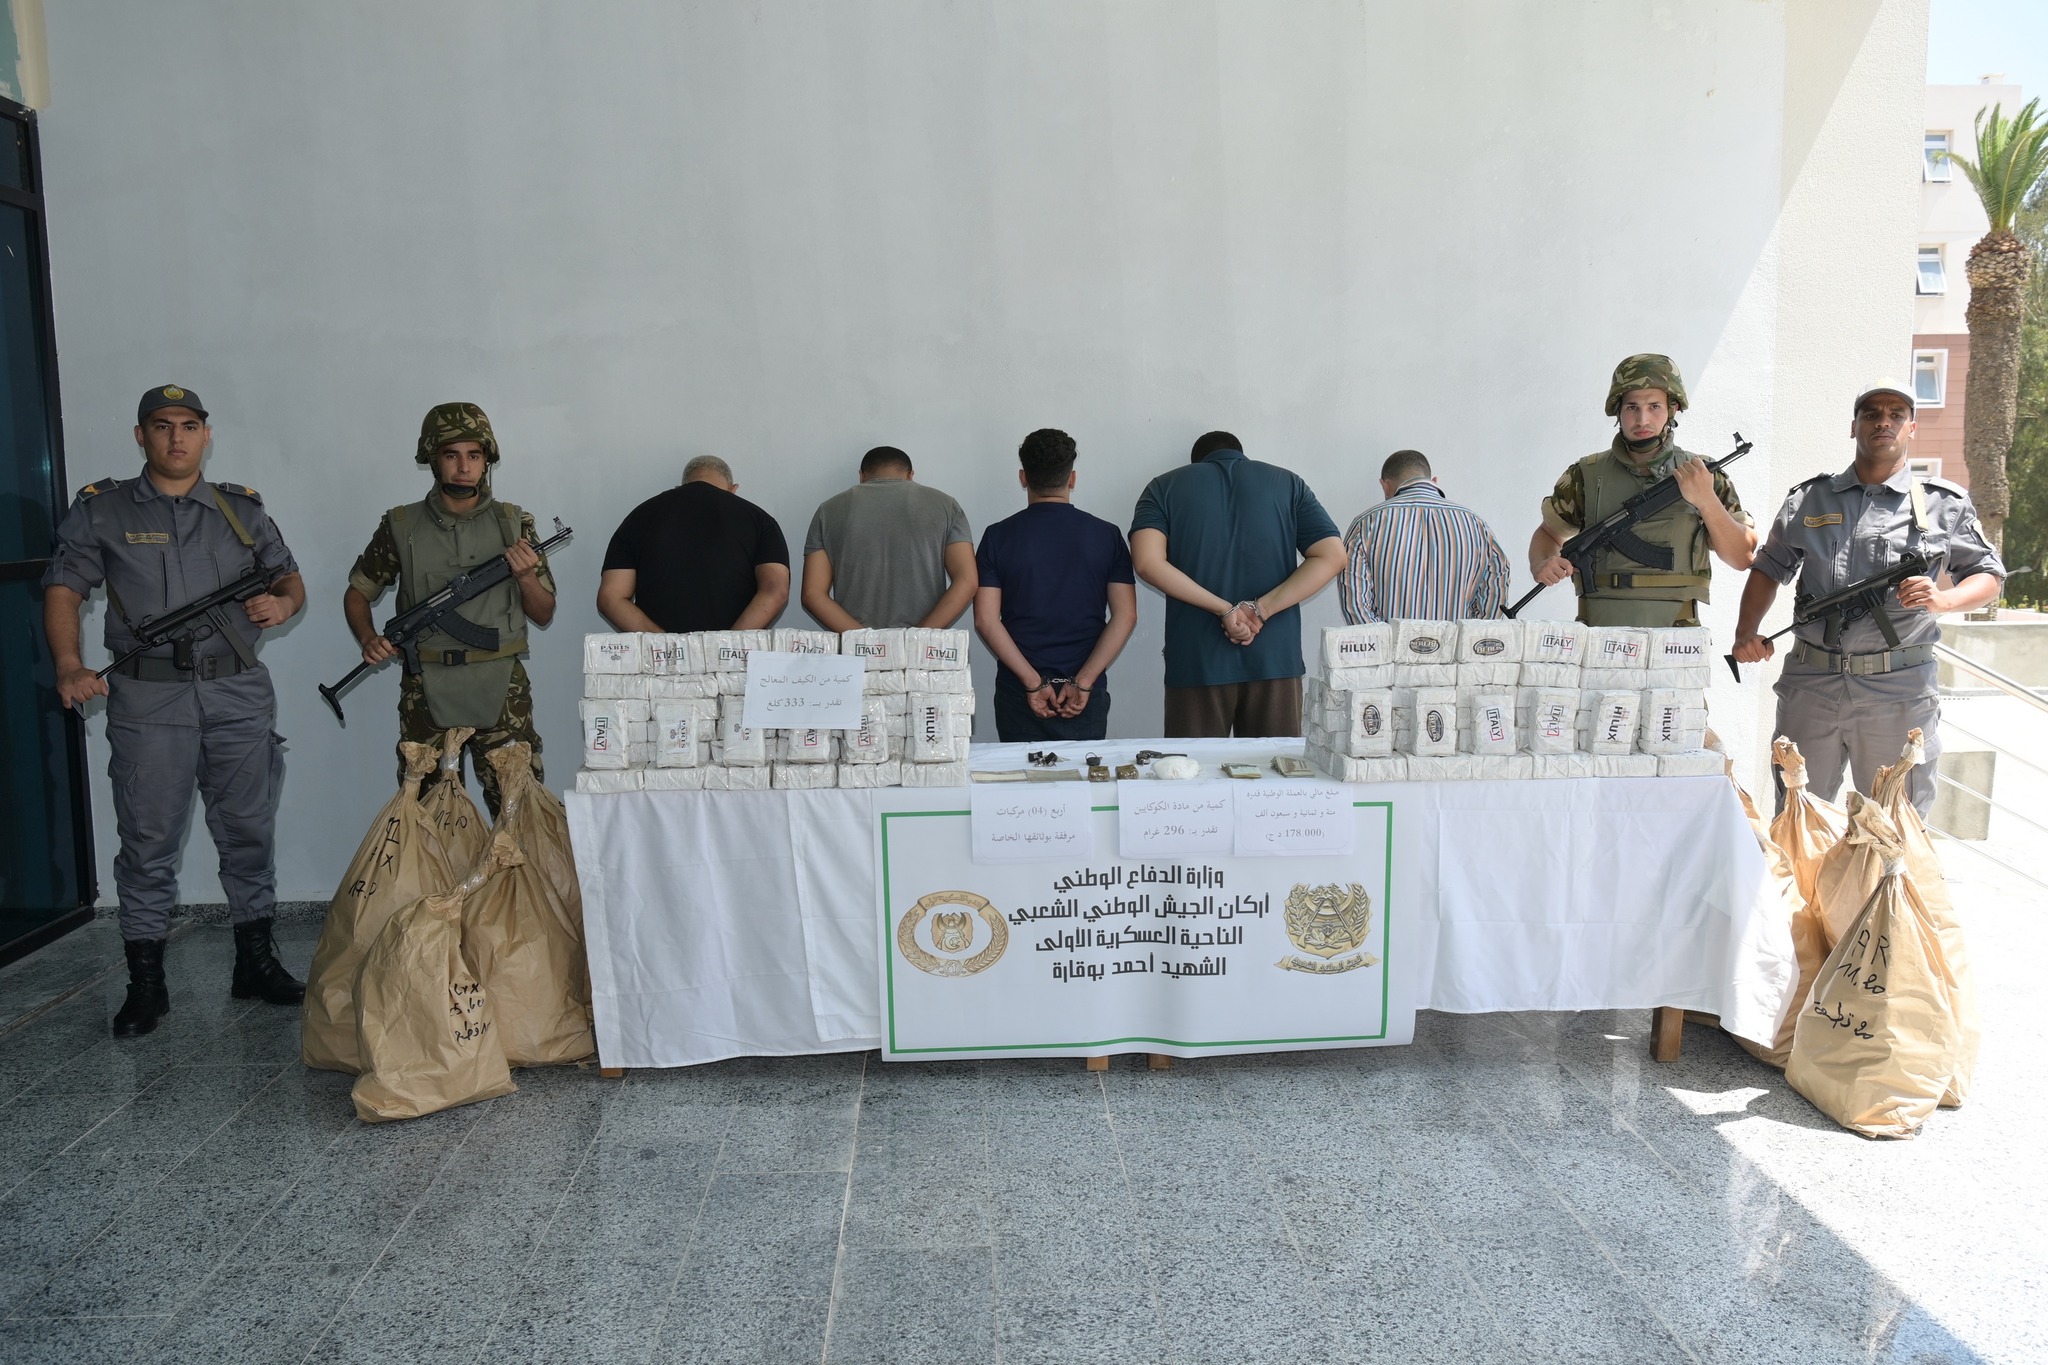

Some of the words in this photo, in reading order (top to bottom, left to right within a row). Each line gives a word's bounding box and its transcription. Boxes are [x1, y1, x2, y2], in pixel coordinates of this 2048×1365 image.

[1545, 637, 1572, 647] ITALY
[857, 646, 883, 655] ITALY
[928, 647, 954, 658] ITALY
[1340, 643, 1376, 654] HILUX
[1608, 643, 1635, 654] ITALY
[1665, 645, 1700, 654] HILUX
[760, 675, 788, 687] المعالج
[792, 674, 816, 684] الكيف
[834, 674, 853, 684] كمية
[784, 697, 804, 707] 333
[825, 699, 842, 709] تقدر
[926, 707, 935, 742] HILUX
[1489, 711, 1501, 738] ITALY
[1549, 708, 1561, 733] ITALY
[1607, 706, 1623, 740] HILUX
[1662, 707, 1672, 741] HILUX
[596, 719, 606, 747] ITALY
[1262, 788, 1283, 799] الوطنية
[1286, 788, 1307, 797] بالعملة
[1173, 802, 1189, 810] مادة
[1192, 804, 1203, 813] من
[1206, 799, 1226, 810] كمية
[996, 805, 1024, 818] مركبات
[1028, 806, 1047, 817] (04)
[1050, 804, 1066, 819] أربع
[1270, 810, 1291, 819] سبعون
[1143, 828, 1160, 839] غرام
[1163, 825, 1185, 835] 296
[1201, 826, 1218, 837] تقدر
[991, 832, 1020, 842] الخاصة
[1024, 833, 1051, 843] بوثائقها
[1055, 832, 1075, 842] مرفقة
[1053, 865, 1121, 894] الوطني
[1126, 864, 1182, 889] الدفاع
[1186, 864, 1224, 889] وزارة
[1083, 894, 1150, 923] الوطني
[1154, 894, 1213, 919] الجيش
[1218, 892, 1270, 919] أركان
[1008, 898, 1078, 926] الشعبي
[1035, 926, 1091, 953] الأولى
[1096, 925, 1176, 950] العسكرية
[1180, 925, 1243, 950] الناحية
[1112, 951, 1154, 975] أحمد
[1161, 956, 1226, 980] الشهيد
[1052, 959, 1104, 983] بوقارة
